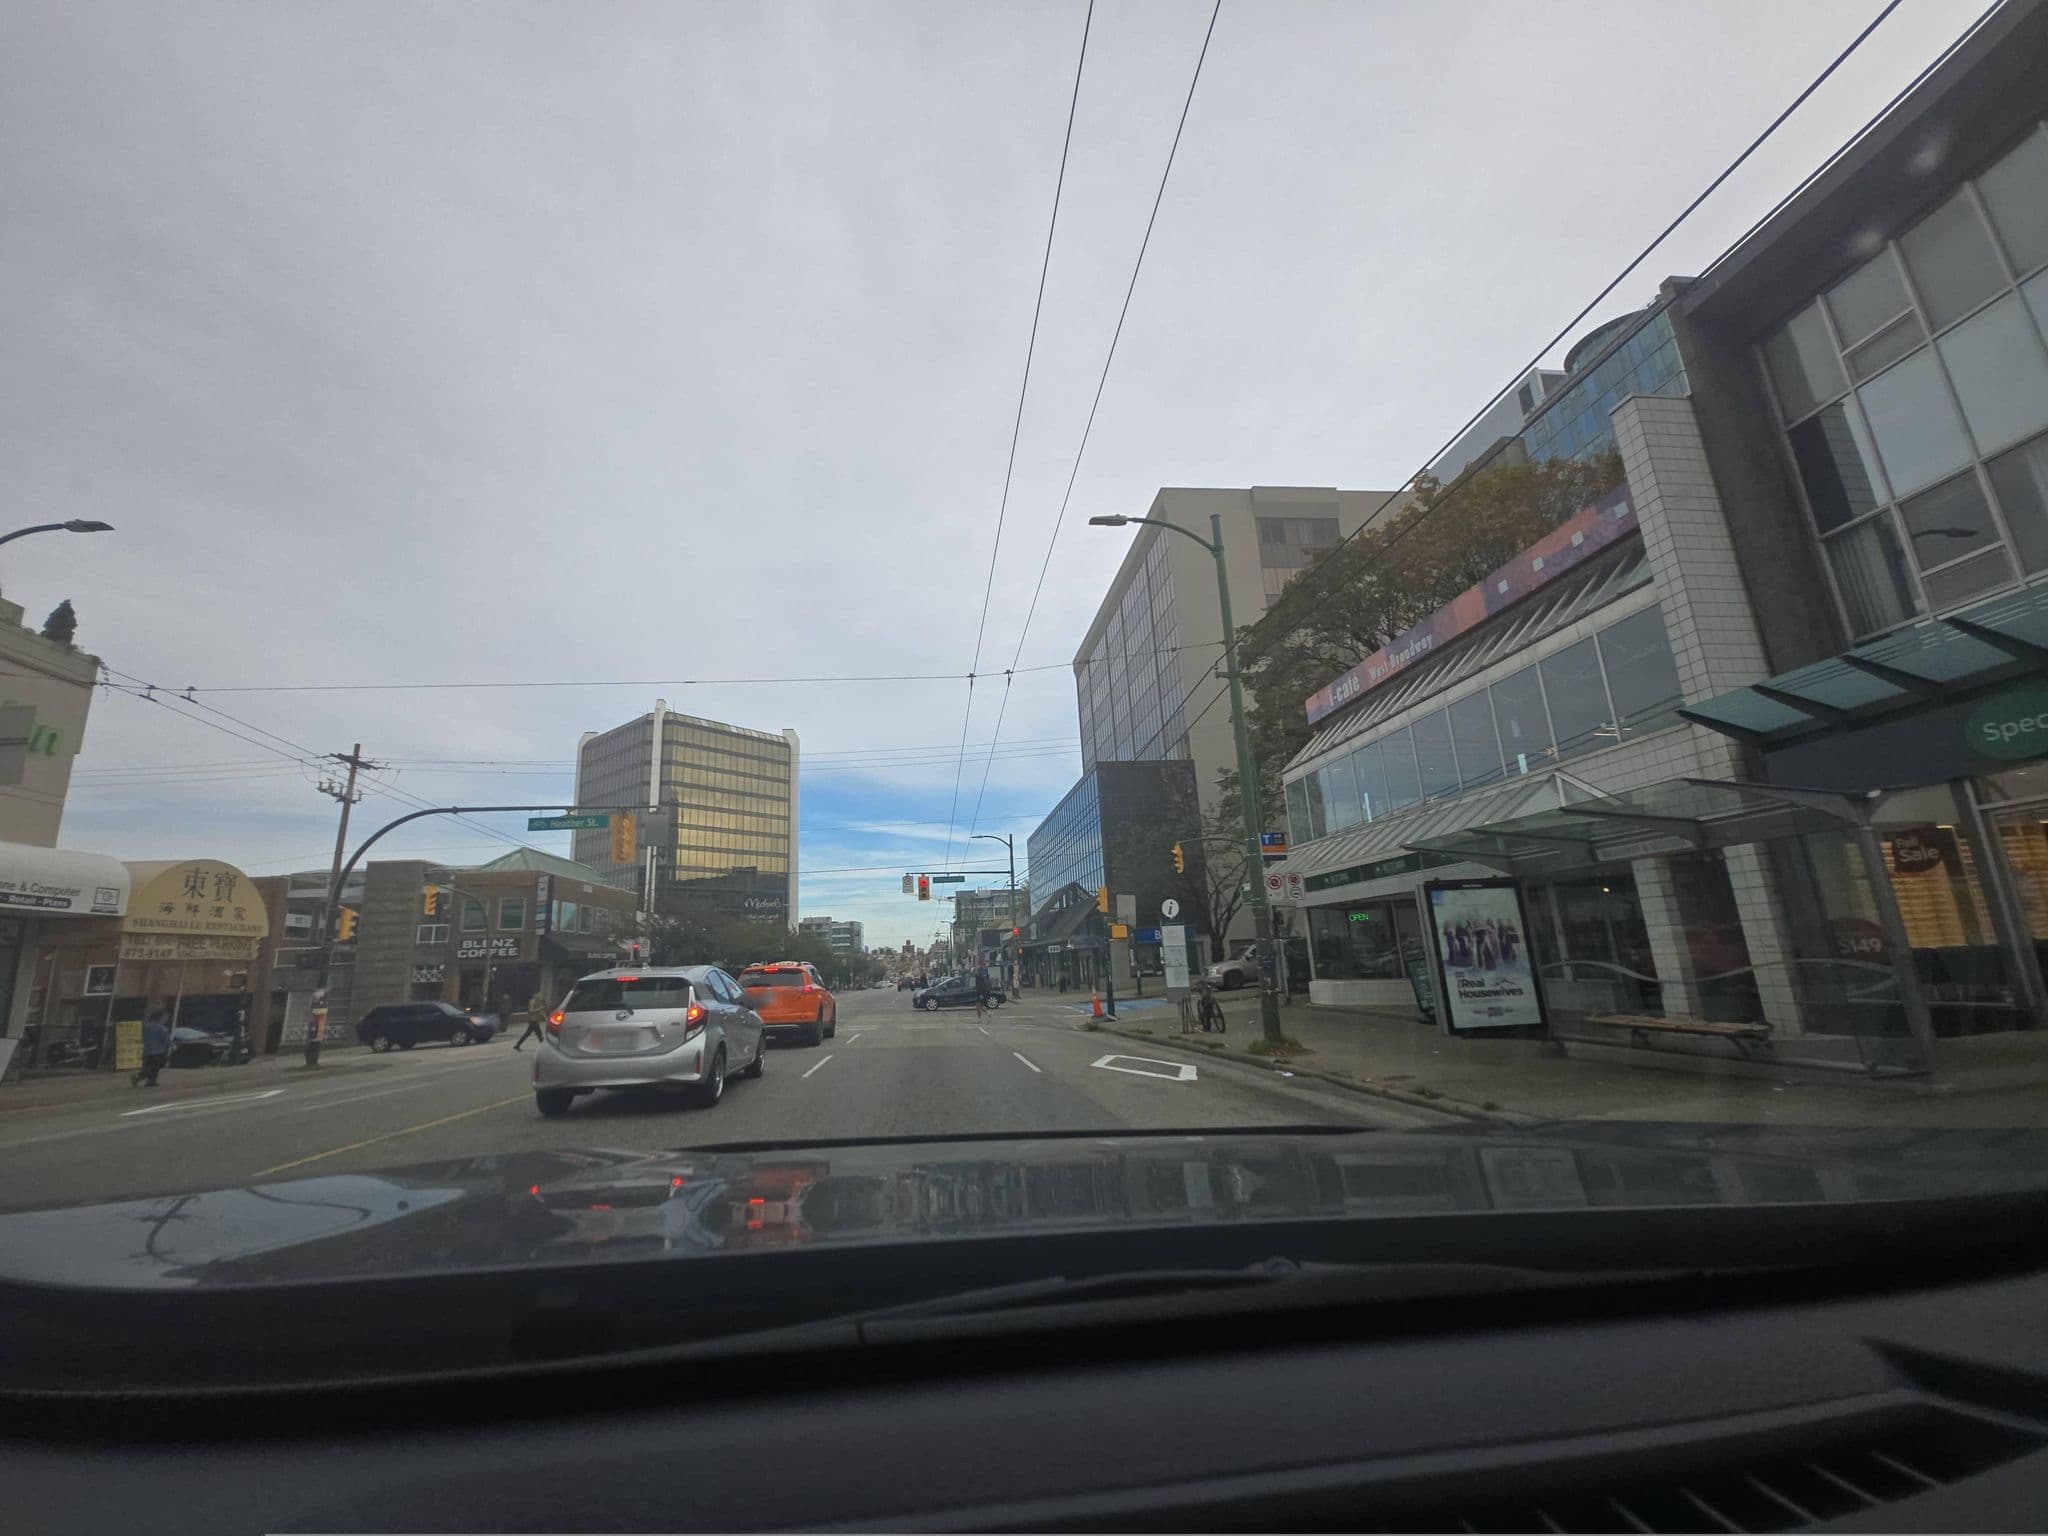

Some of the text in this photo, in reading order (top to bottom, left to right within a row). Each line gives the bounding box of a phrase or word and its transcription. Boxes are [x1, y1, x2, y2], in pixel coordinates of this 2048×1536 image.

[1389, 634, 1433, 669] Broadway
[1899, 846, 1940, 862] Sale
[31, 883, 81, 897] Computer
[1348, 912, 1369, 922] OPEN
[457, 947, 519, 959] COFFEE
[1461, 977, 1485, 988] Real
[1458, 986, 1524, 999] Housewives
